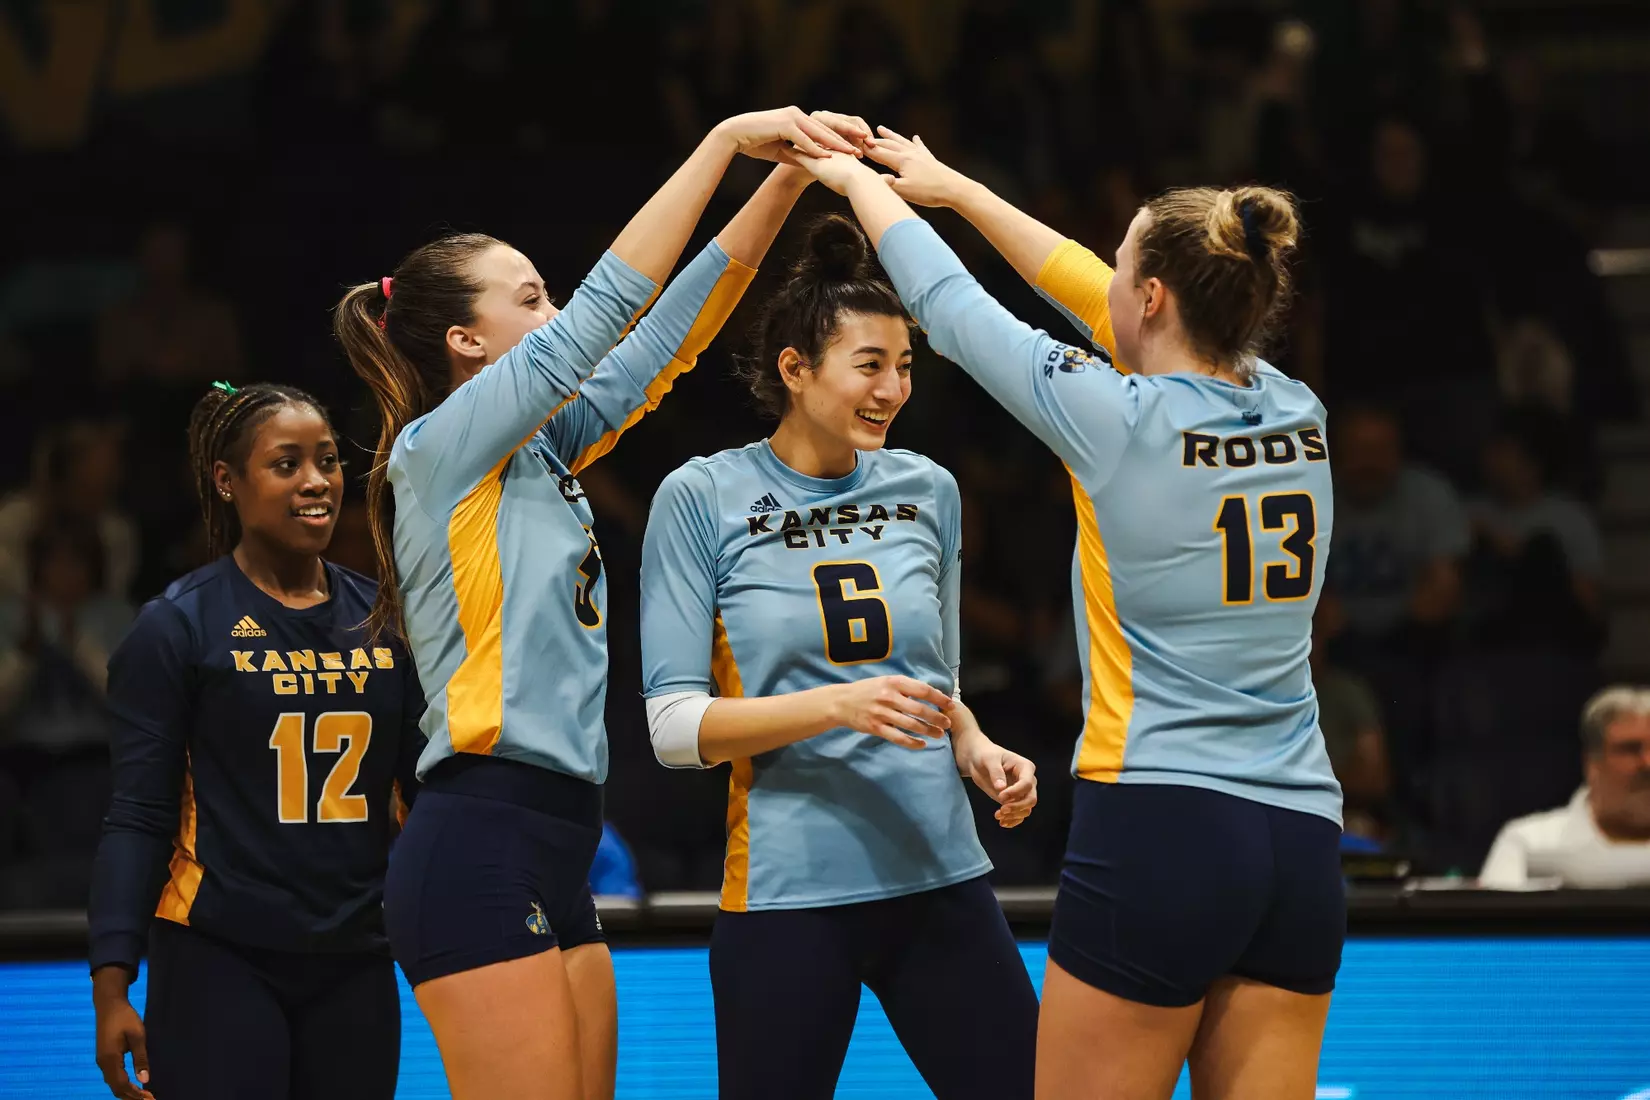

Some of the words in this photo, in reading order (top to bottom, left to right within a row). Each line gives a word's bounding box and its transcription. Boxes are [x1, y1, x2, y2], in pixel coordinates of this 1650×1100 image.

[1182, 427, 1328, 469] ROOS
[746, 503, 919, 537] KANSAS
[783, 524, 884, 550] CITY
[1212, 490, 1317, 606] 13
[810, 560, 893, 667] 6
[231, 628, 267, 638] adidas
[229, 647, 395, 673] KANSAS
[272, 671, 370, 696] CITY
[268, 711, 373, 824] 12
